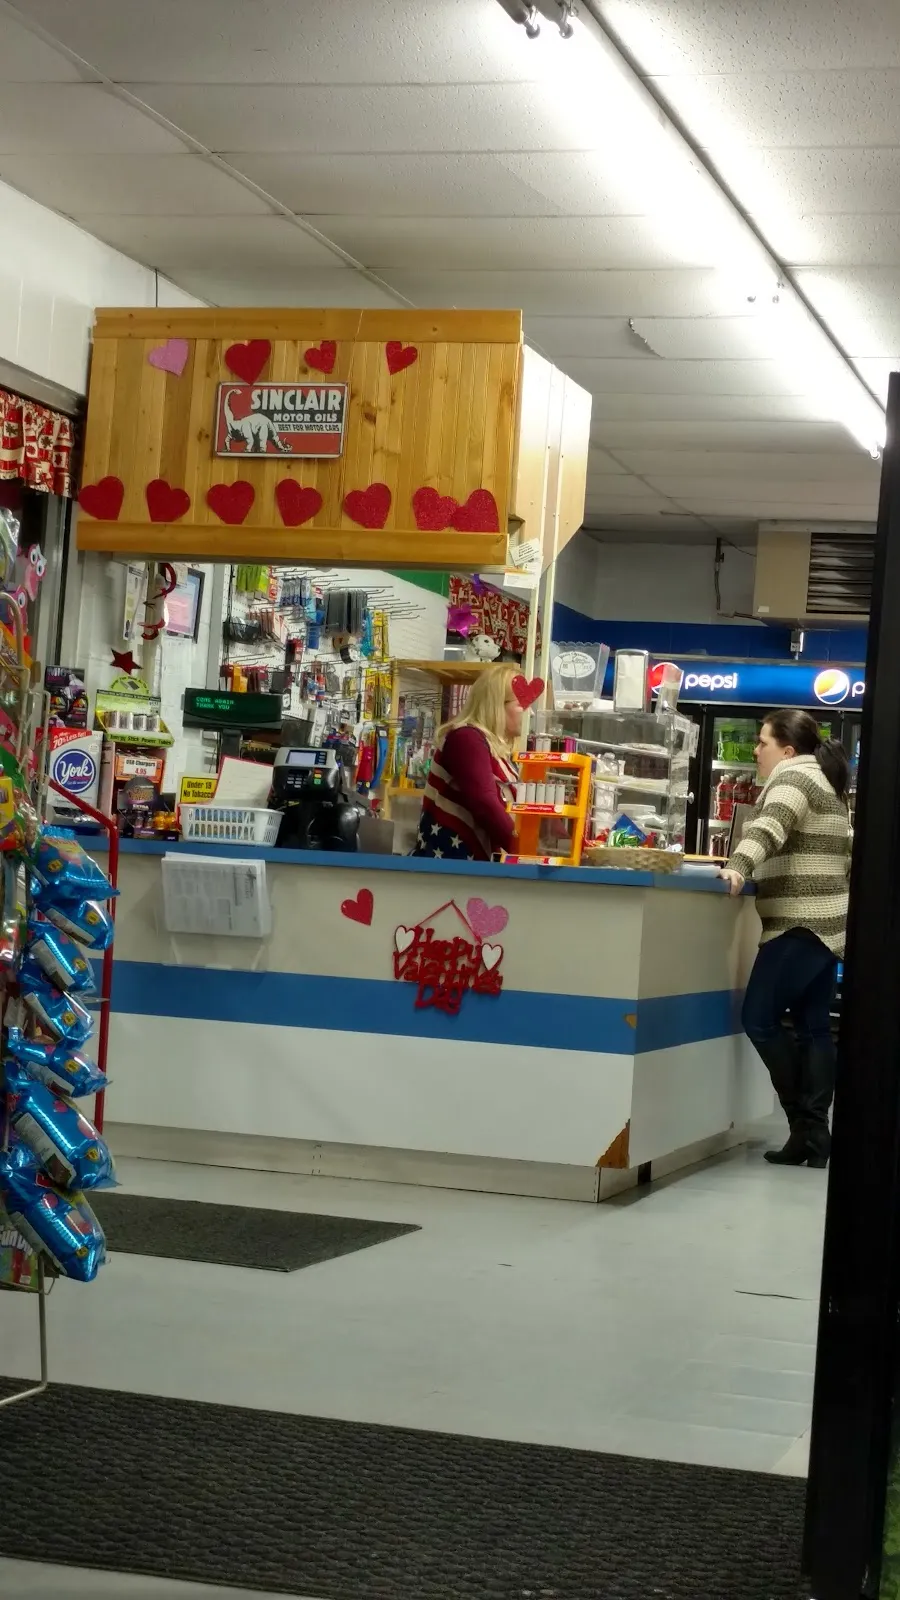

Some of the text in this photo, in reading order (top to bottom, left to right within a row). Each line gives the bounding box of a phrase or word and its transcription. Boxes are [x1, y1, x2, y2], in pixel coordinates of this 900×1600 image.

[251, 389, 342, 411] SINCLAIR
[273, 413, 338, 422] MOTOR OILS
[305, 424, 324, 432] MOTOR
[324, 424, 340, 432] CARS
[685, 672, 738, 691] pepsi
[60, 759, 93, 784] York
[186, 781, 204, 789] Under
[411, 926, 483, 966] Happy
[414, 981, 464, 1015] Day
